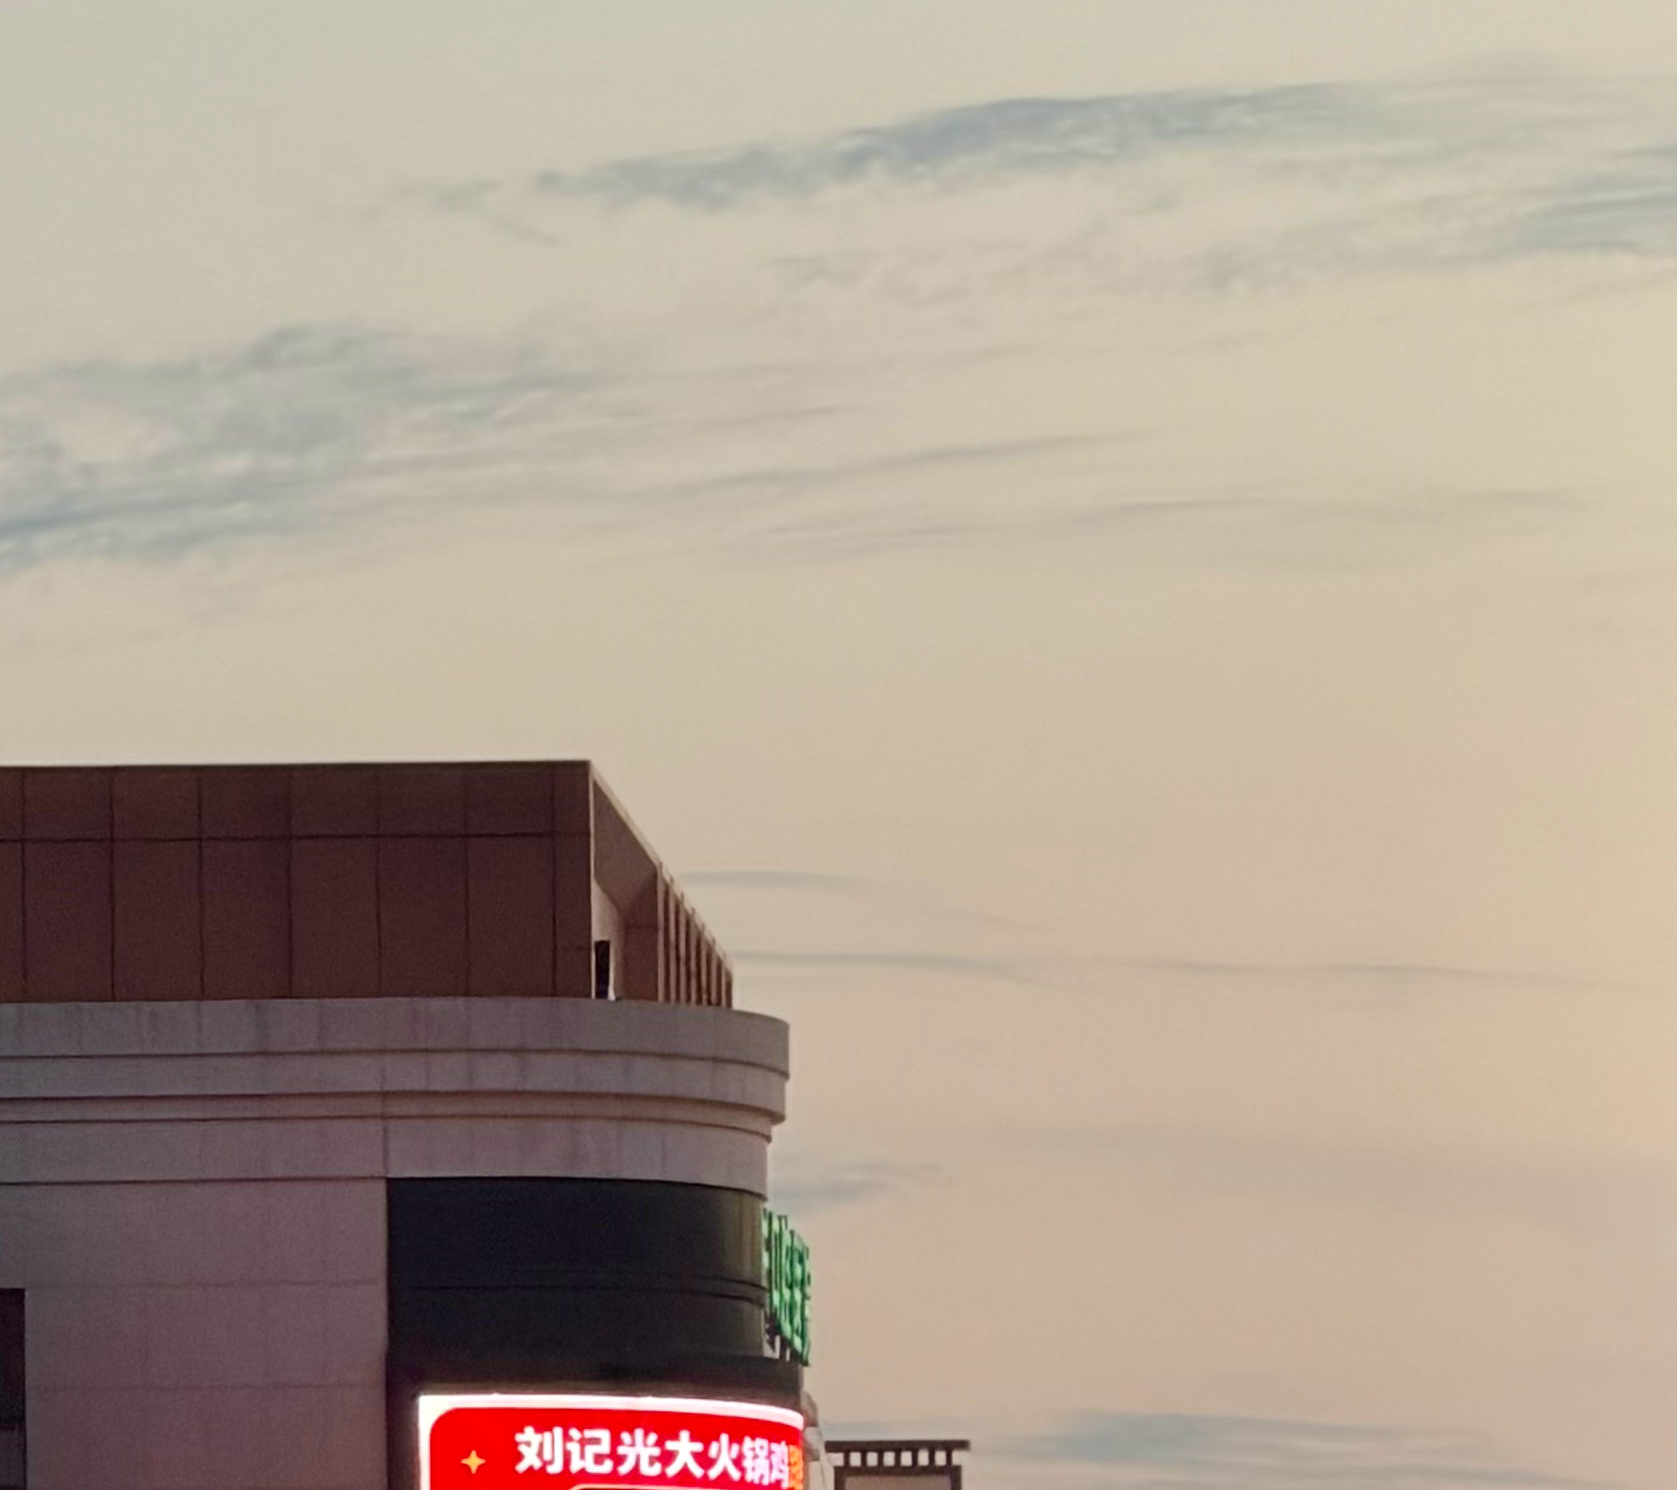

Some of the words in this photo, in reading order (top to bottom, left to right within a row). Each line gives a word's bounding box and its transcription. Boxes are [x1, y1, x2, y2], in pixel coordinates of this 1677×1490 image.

[514, 1425, 789, 1489] 刘记光大火锅鸡
